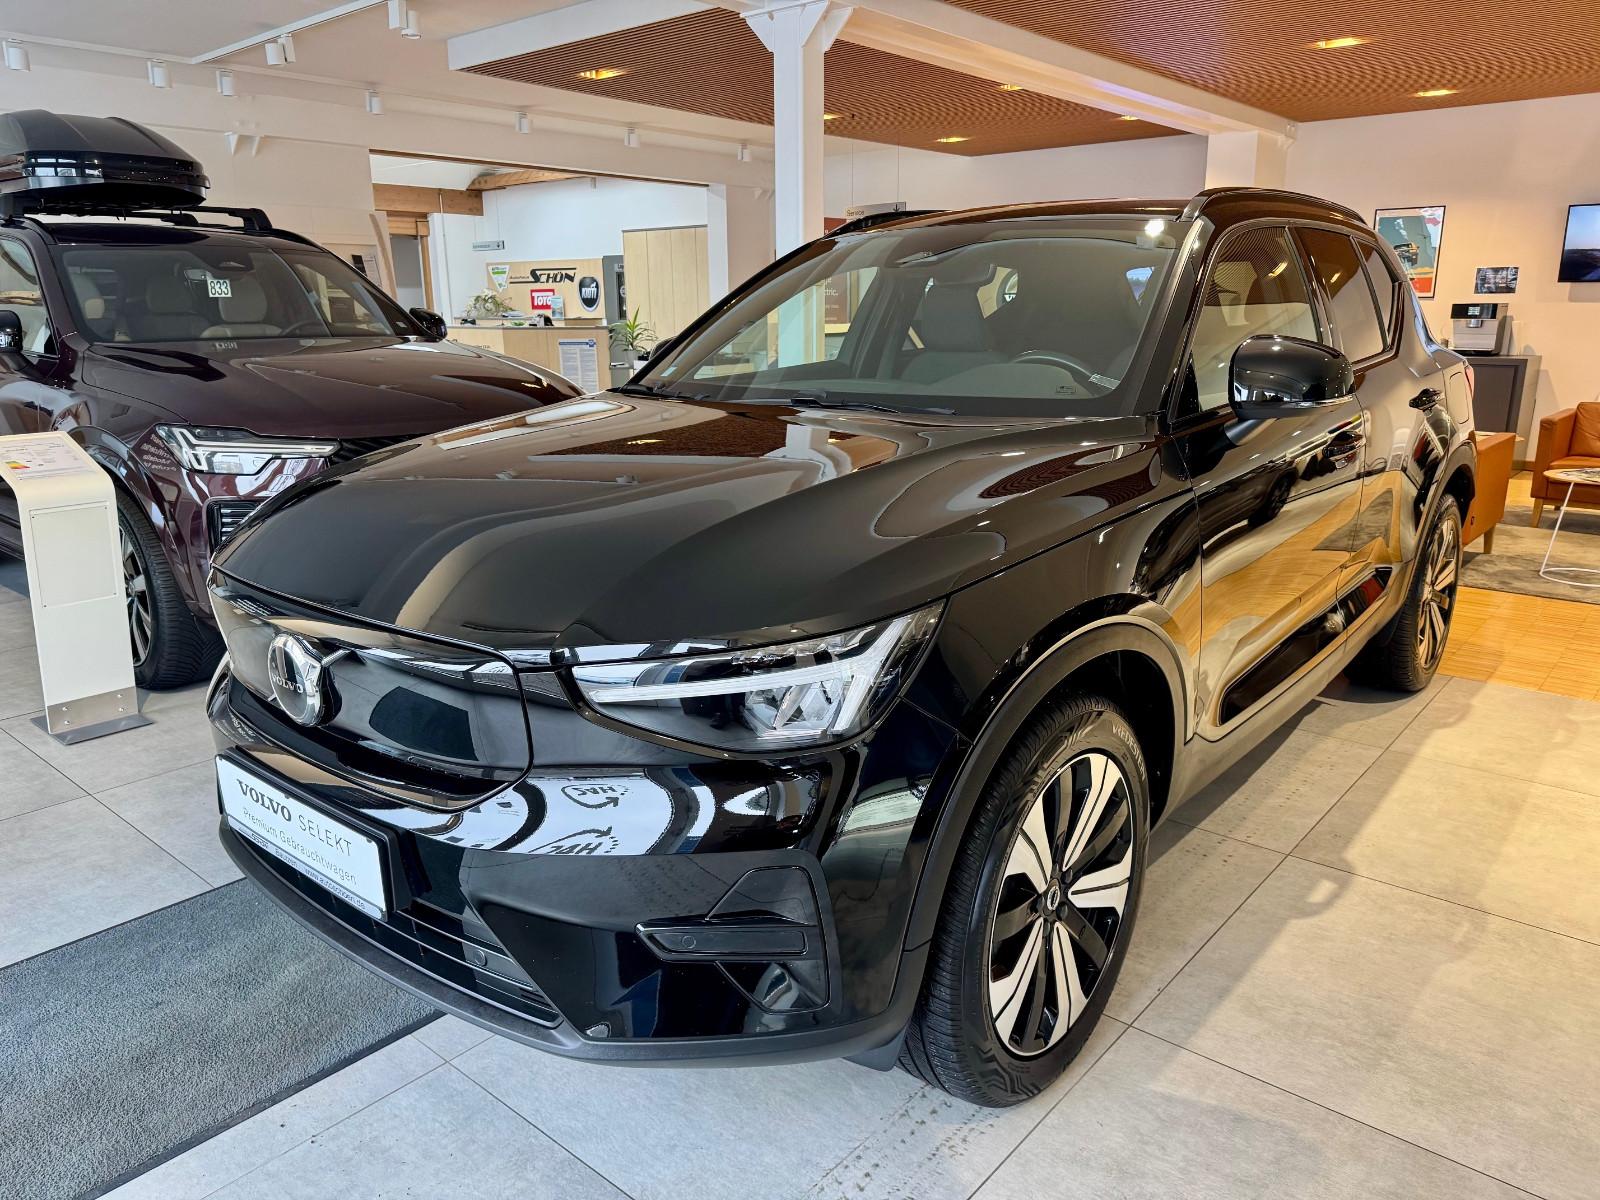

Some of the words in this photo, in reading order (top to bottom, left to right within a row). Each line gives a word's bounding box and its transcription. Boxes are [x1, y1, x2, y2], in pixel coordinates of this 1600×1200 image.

[846, 209, 865, 217] Service
[530, 267, 577, 284] SCHÖN
[209, 280, 229, 296] 833
[272, 673, 304, 694] VOLVO
[236, 778, 292, 822] VOLVO
[298, 814, 352, 857] SELEKT
[243, 807, 279, 838] Premium
[280, 830, 358, 885] Gebrauchtwagen
